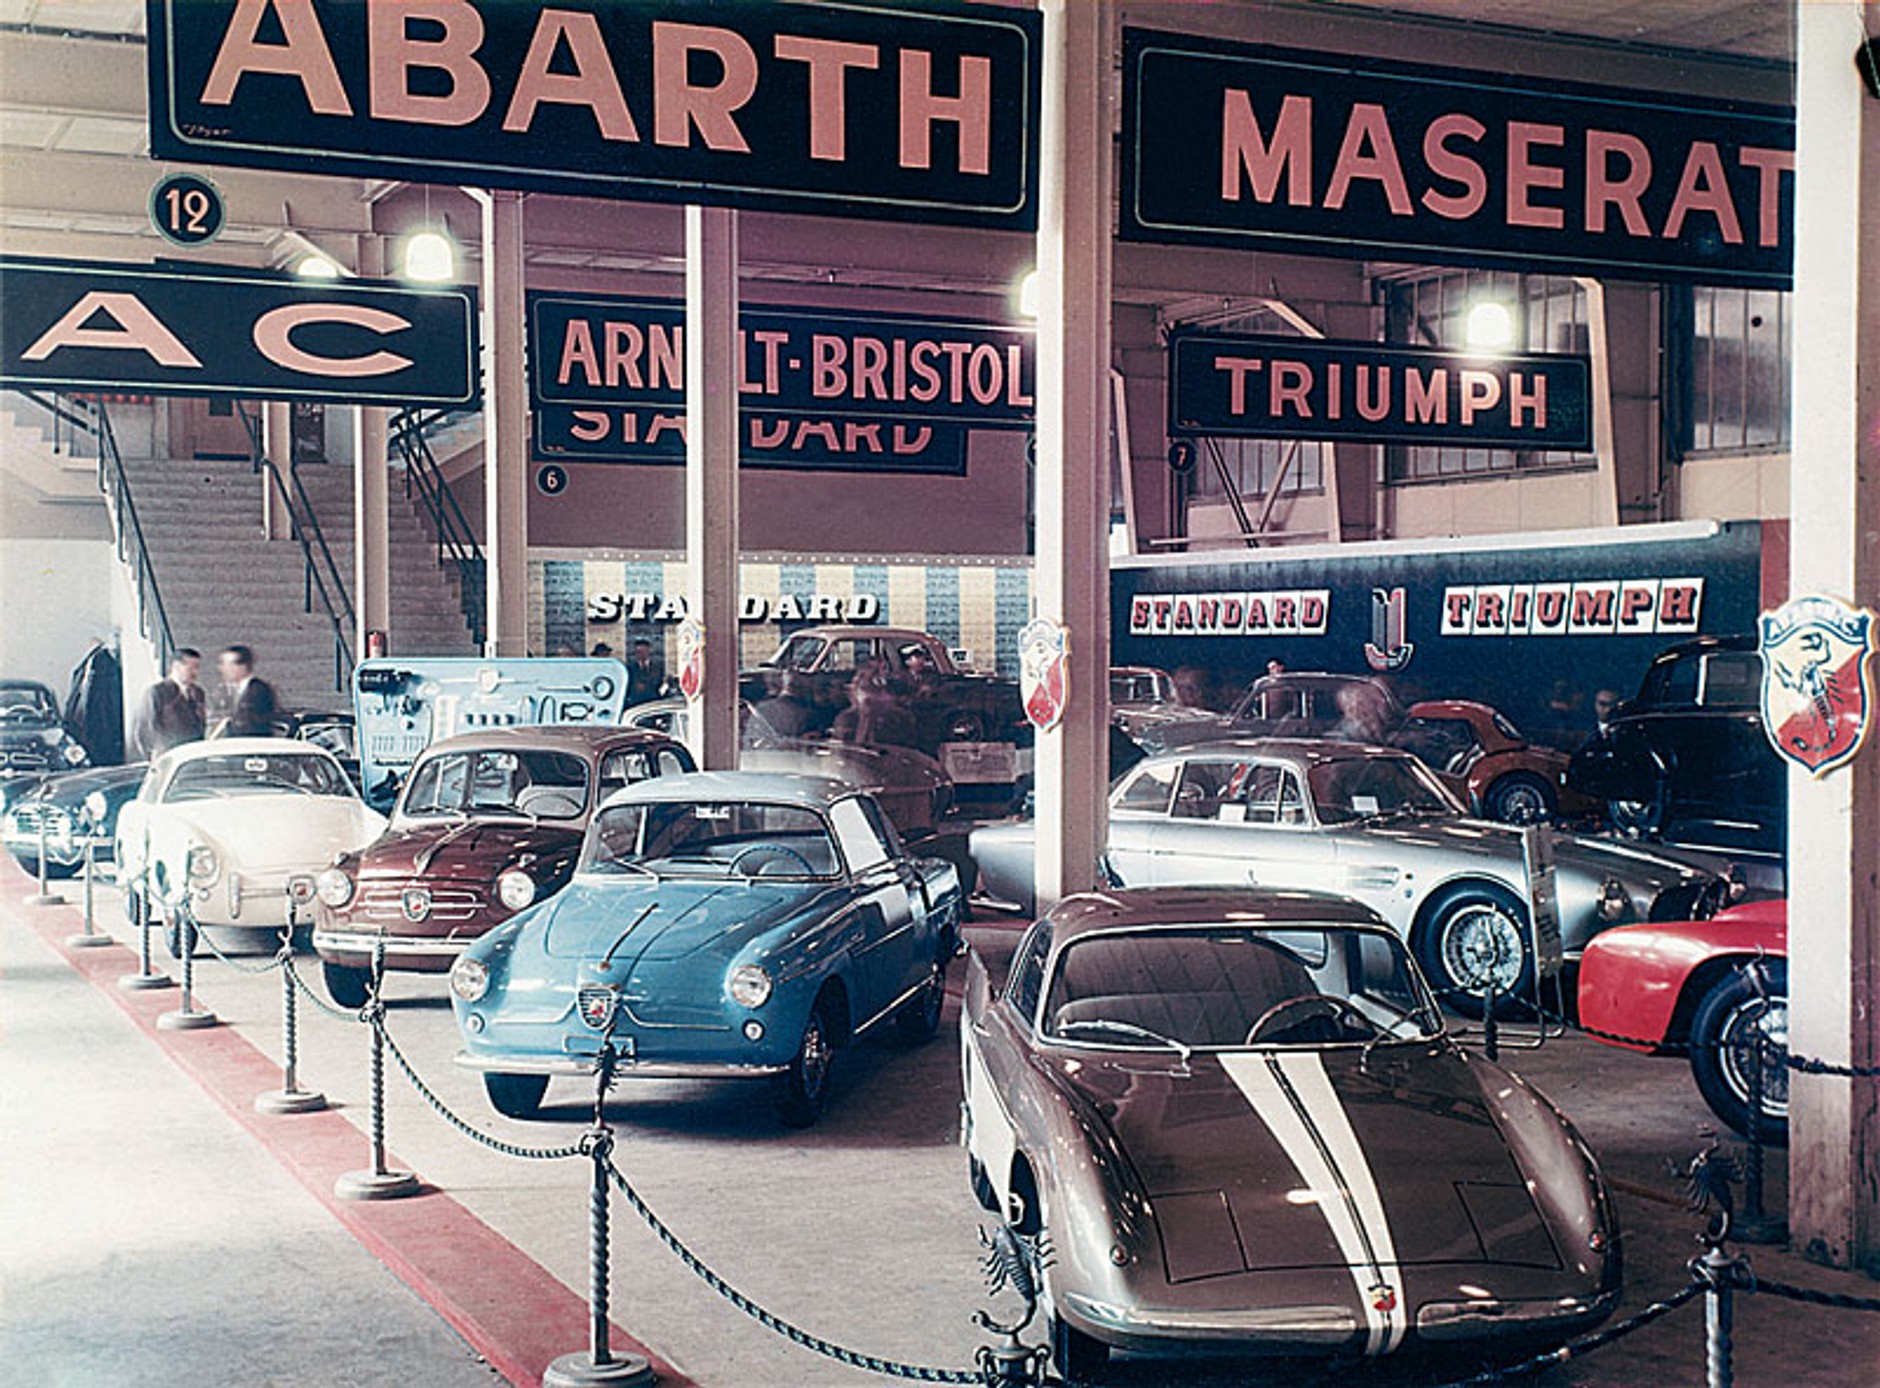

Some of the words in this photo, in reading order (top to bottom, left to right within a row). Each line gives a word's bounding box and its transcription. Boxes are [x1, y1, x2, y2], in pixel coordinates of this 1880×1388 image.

[200, 0, 991, 175] ABARTH
[1221, 88, 1796, 247] MASERAT
[166, 188, 209, 233] 12
[557, 319, 1034, 407] ARNLT-BRISTOL
[1214, 356, 1548, 429] TRIUMPH
[547, 471, 558, 490] 6
[587, 592, 879, 623] STADARD
[1132, 597, 1326, 630] STANDARD
[1447, 586, 1697, 627] TRIUMPH
